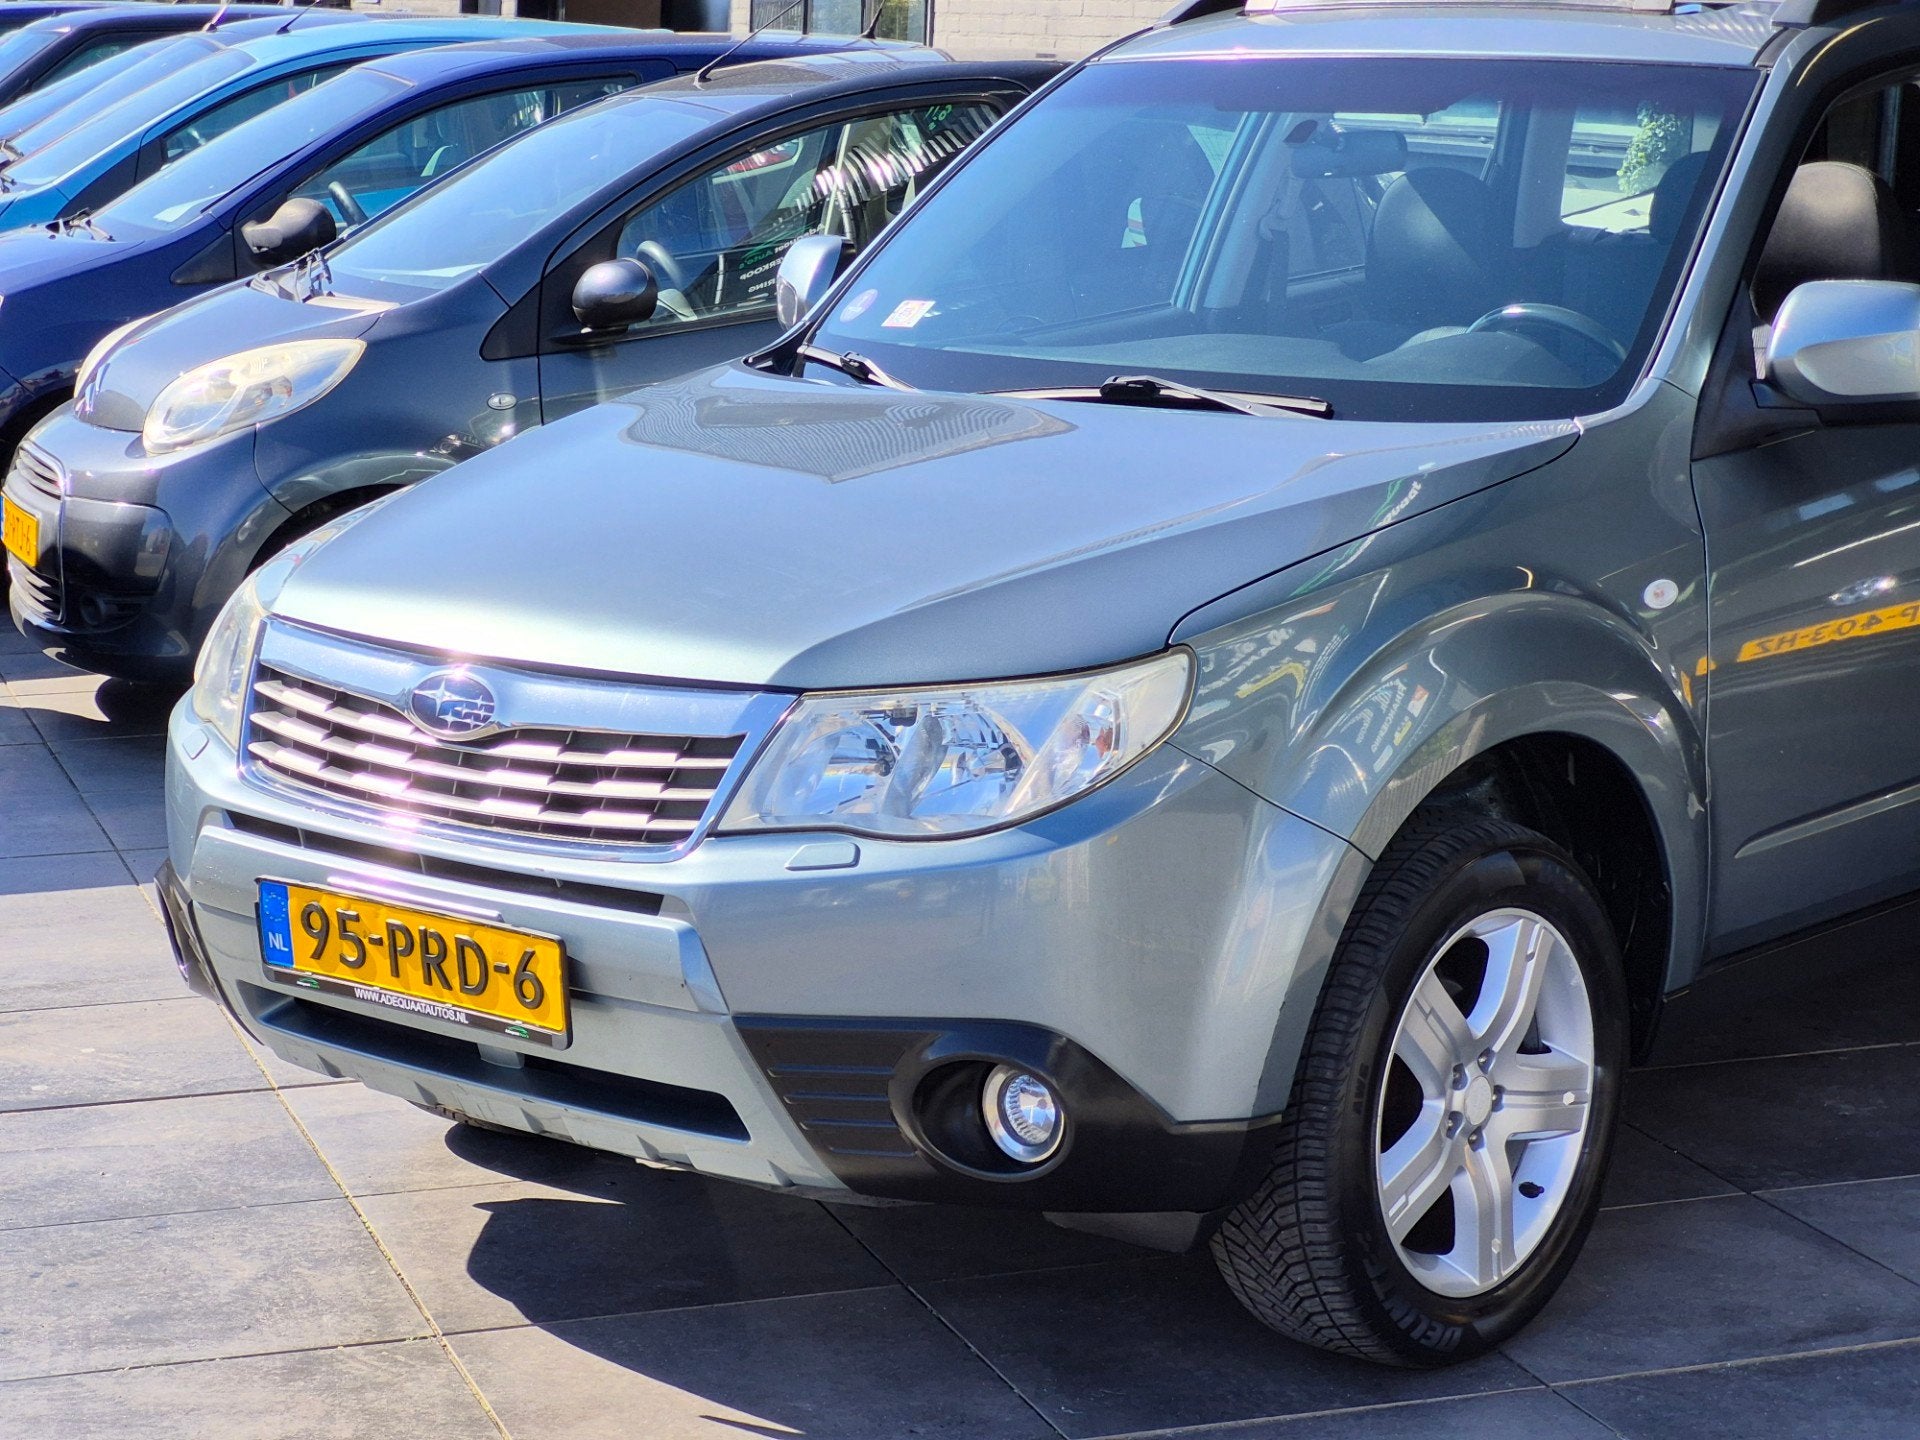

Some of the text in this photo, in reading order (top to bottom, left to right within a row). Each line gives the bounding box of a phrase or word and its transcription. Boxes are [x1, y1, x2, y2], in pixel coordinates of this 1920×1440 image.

[268, 931, 290, 952] NL
[301, 902, 544, 1010] 95-PRD-6
[354, 987, 469, 1024] WWW.ADEQUAATAUTOS.NL
